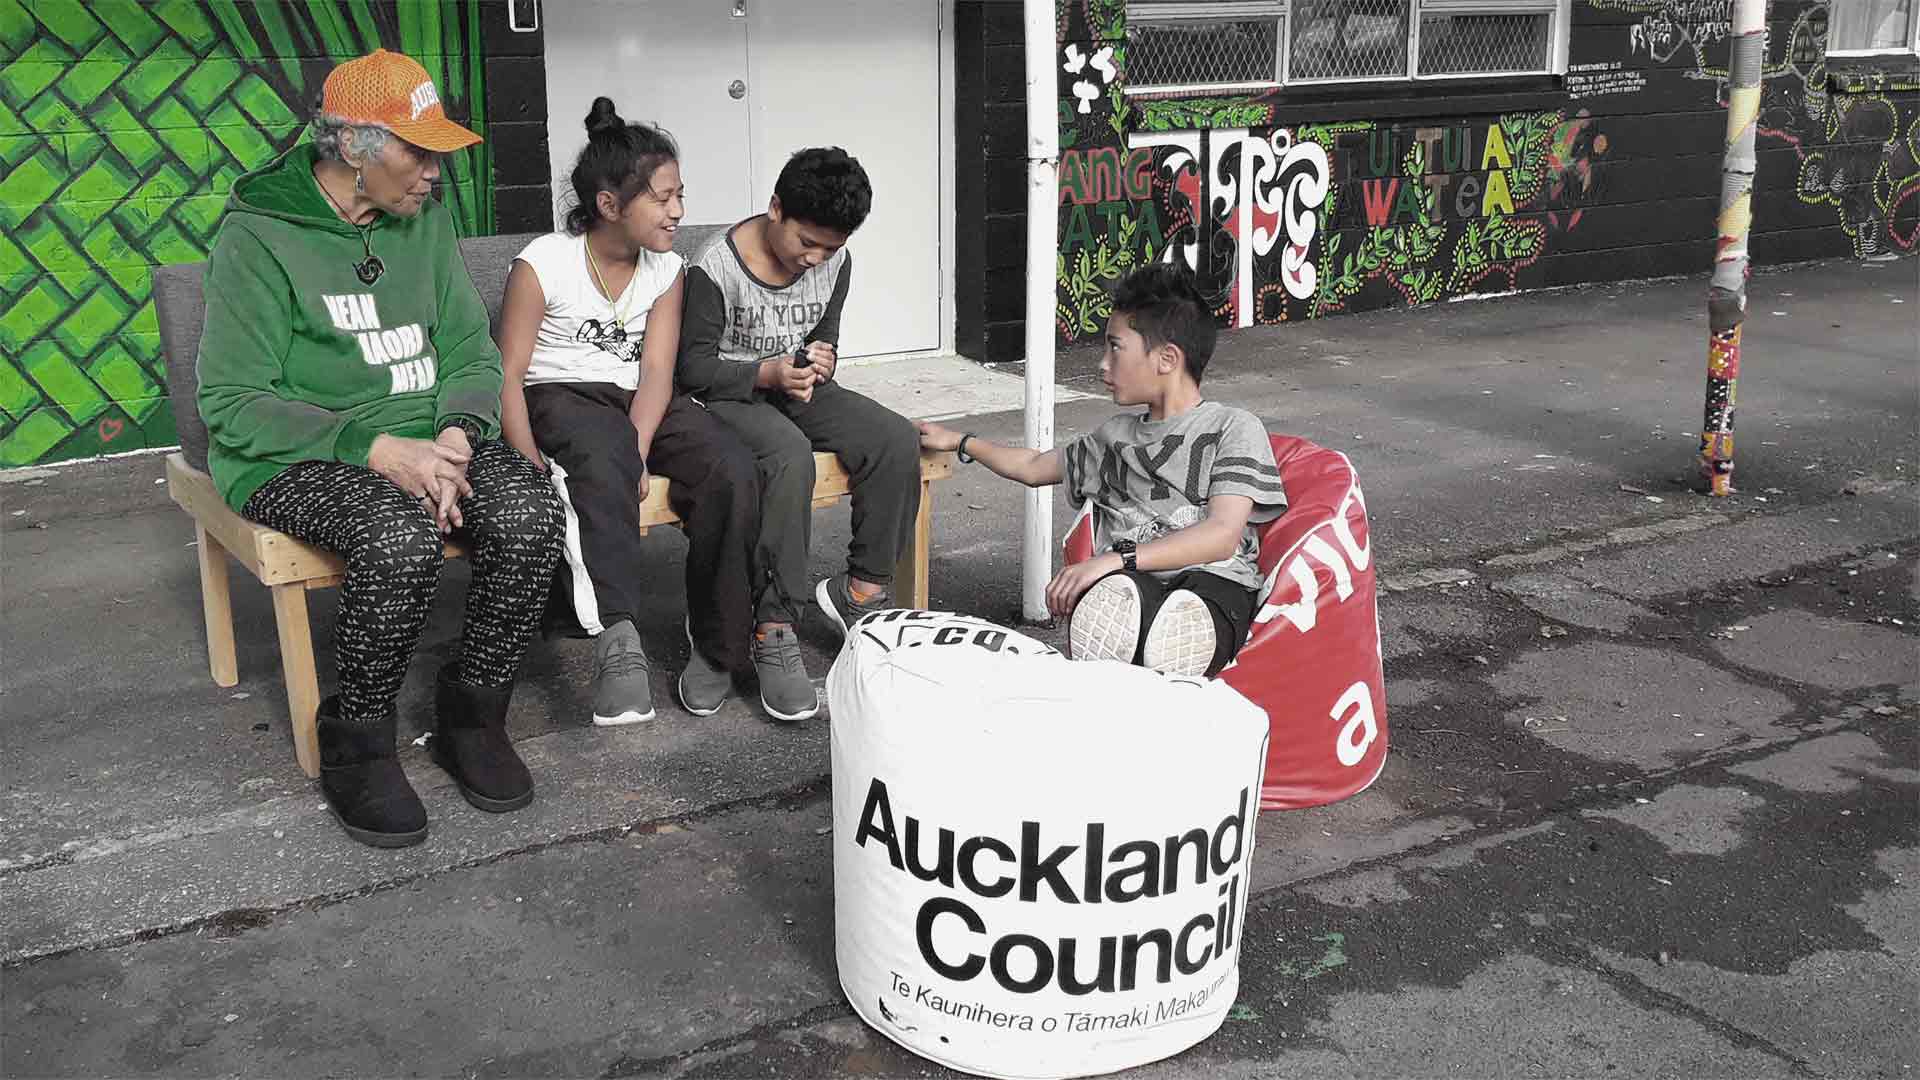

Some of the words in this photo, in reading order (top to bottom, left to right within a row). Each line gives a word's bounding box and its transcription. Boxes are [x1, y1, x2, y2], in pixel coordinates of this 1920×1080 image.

[773, 301, 829, 327] YOR
[854, 776, 1249, 904] Auckland
[914, 874, 1240, 996] Council
[889, 970, 911, 998] Te
[915, 984, 1034, 1032] Kaunihera
[1041, 1016, 1057, 1033] o
[1063, 1003, 1151, 1034] Tāmaki
